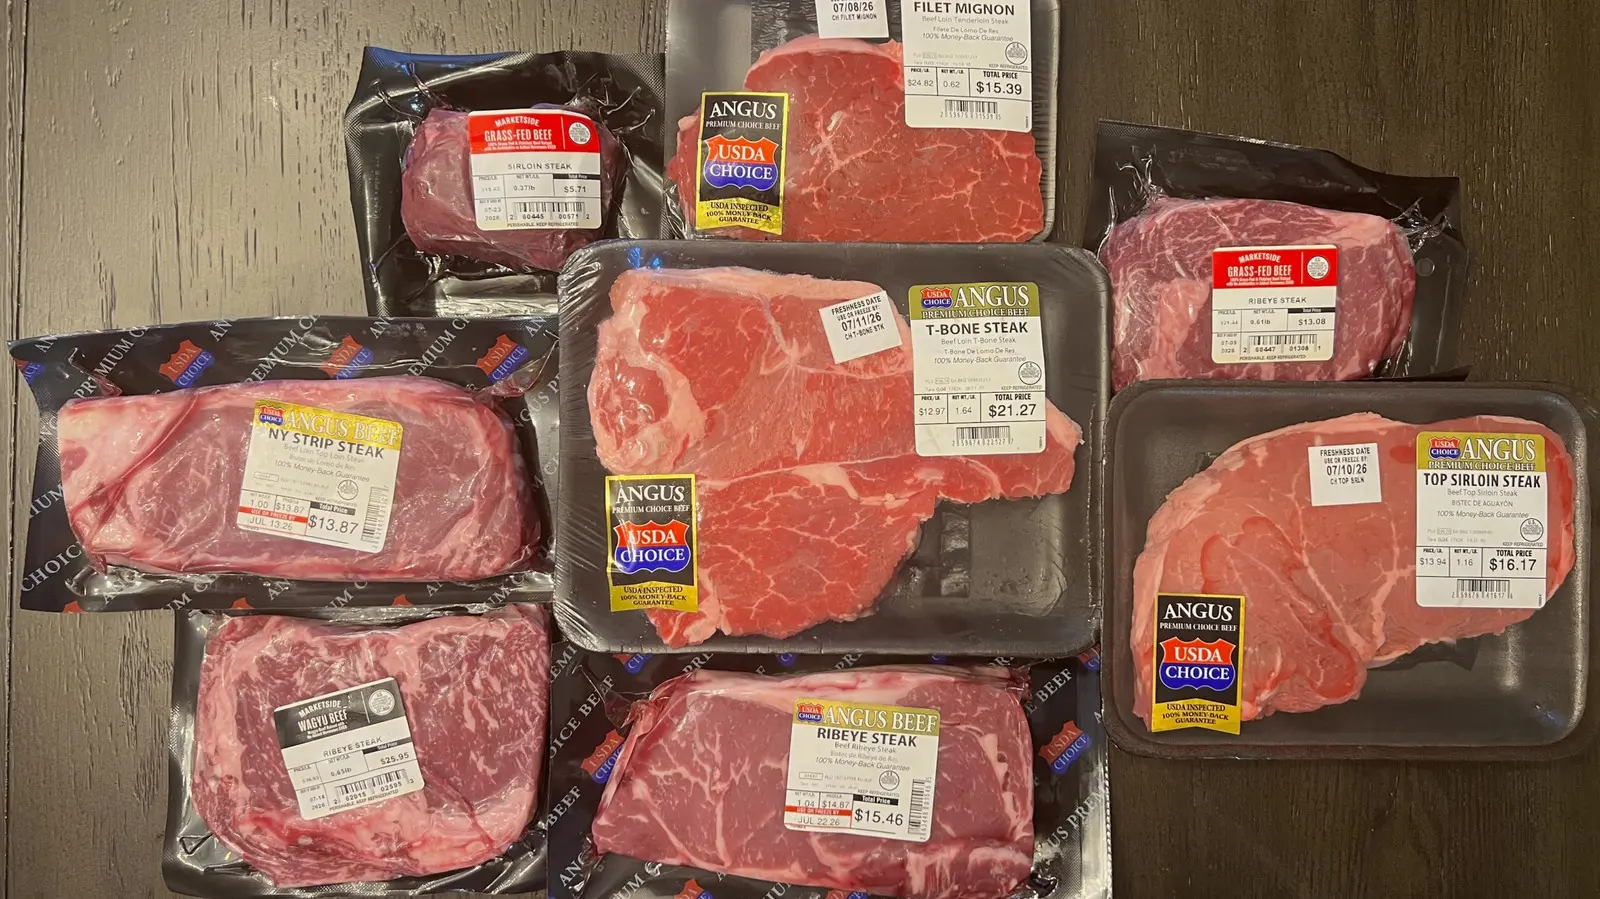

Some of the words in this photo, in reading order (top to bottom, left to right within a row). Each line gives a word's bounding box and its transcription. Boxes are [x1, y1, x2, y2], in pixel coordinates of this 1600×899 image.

[833, 2, 873, 12] 07/08/26
[914, 2, 951, 13] FILET
[956, 3, 1014, 16] MIGNON
[976, 81, 1022, 95] $15.39
[710, 101, 777, 119] ANGUS
[495, 116, 539, 127] MARKETSIDE
[738, 121, 763, 129] CHOICE
[765, 122, 781, 130] BEEF
[485, 130, 531, 141] GRASS-FED
[534, 129, 552, 140] BEEF
[718, 144, 766, 161] USDA
[710, 164, 772, 179] CHOICE
[731, 202, 768, 211] INSPECTED
[719, 216, 759, 224] GUARANTEE
[1239, 253, 1280, 263] MARKETSIDE
[1228, 266, 1272, 277] GRASS-FED
[1274, 265, 1292, 277] BEEF
[954, 286, 1029, 308] ANGUS
[832, 300, 865, 315] FRESHNESS
[866, 296, 881, 306] DATE
[922, 310, 966, 319] PREMIUM
[1008, 308, 1029, 316] BEEF
[842, 312, 882, 331] 07/11/26
[1298, 318, 1326, 326] $13.08
[853, 327, 873, 338] T-BONE
[874, 324, 885, 332] STK
[926, 324, 980, 336] T-BONE
[984, 322, 1028, 333] STEAK
[168, 347, 197, 374] USDA
[484, 342, 512, 367] USDA
[953, 356, 992, 364] Money-Back
[178, 351, 212, 386] CHOICE
[492, 346, 526, 380] CHOICE
[264, 408, 281, 416] USDA
[919, 408, 945, 416] $12.97
[989, 404, 1036, 418] $21.27
[285, 410, 349, 437] ANGUS
[354, 423, 399, 445] BEEF
[269, 428, 290, 441] NY
[293, 433, 333, 449] STRIP
[338, 441, 385, 459] STEAK
[1461, 439, 1536, 460] ANGUS
[1327, 464, 1367, 476] 07/10/26
[1429, 461, 1473, 470] PREMIUM
[1475, 462, 1512, 470] CHOICE
[1515, 463, 1535, 471] BEEF
[1424, 473, 1447, 485] TOP
[1451, 474, 1498, 487] SIRLOIN
[1503, 475, 1540, 488] STEAK
[616, 485, 685, 503] ANGUS
[250, 500, 268, 508] 1.00
[276, 502, 304, 514] $13.87
[333, 505, 348, 513] Price
[308, 515, 358, 534] $13.87
[629, 529, 678, 544] USDA
[621, 549, 685, 562] CHOICE
[1490, 558, 1536, 571] $16.17
[1164, 603, 1233, 621] ANGUS
[1175, 647, 1223, 662] USDA
[1166, 666, 1229, 680] CHOICE
[1036, 668, 1073, 703] BEEF
[298, 700, 341, 717] MARKETSIDE
[298, 716, 327, 732] WAGYU
[330, 710, 348, 723] BEEF
[824, 707, 887, 728] ANGUS
[892, 712, 937, 732] BEEF
[1182, 712, 1228, 720] MONEY-BACK
[818, 728, 867, 742] RIBEYE
[872, 733, 917, 747] STEAK
[1047, 730, 1077, 757] USDA
[323, 744, 352, 757] RIBEYE
[355, 737, 382, 749] STEAK
[852, 743, 875, 752] Ribeye
[1054, 734, 1088, 770] CHOICE
[381, 753, 409, 765] $25.95
[835, 758, 874, 768] Money-Back
[877, 762, 910, 771] Guarantee
[547, 786, 581, 826] BEEF
[822, 800, 849, 808] $14.87
[855, 808, 903, 826] $15.46
